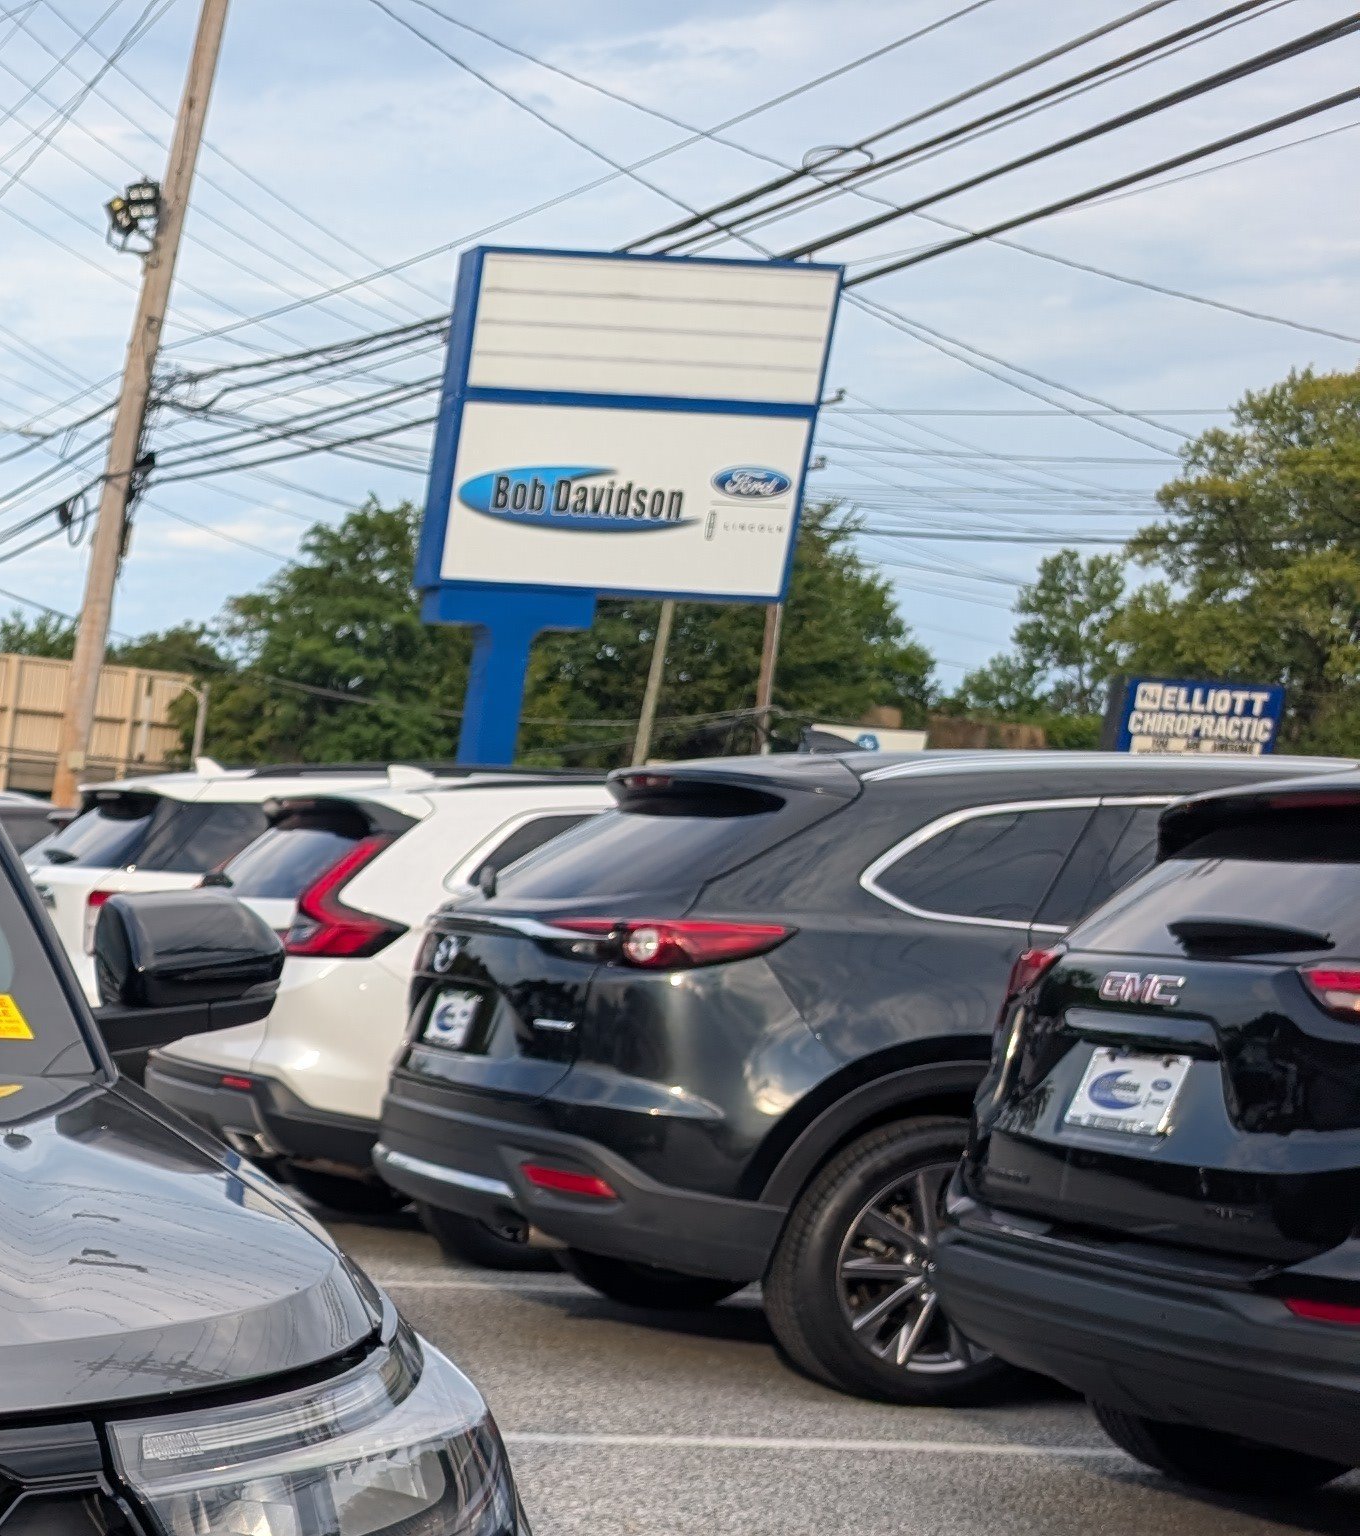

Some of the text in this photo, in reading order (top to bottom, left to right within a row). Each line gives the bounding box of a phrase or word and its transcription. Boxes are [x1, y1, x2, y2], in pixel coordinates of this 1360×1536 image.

[490, 474, 685, 522] Bob Davidson
[724, 469, 780, 496] Ford
[1161, 686, 1271, 717] ELLIOTT
[1128, 711, 1275, 743] CHIROPRACTIC
[1099, 971, 1186, 1006] GMC
